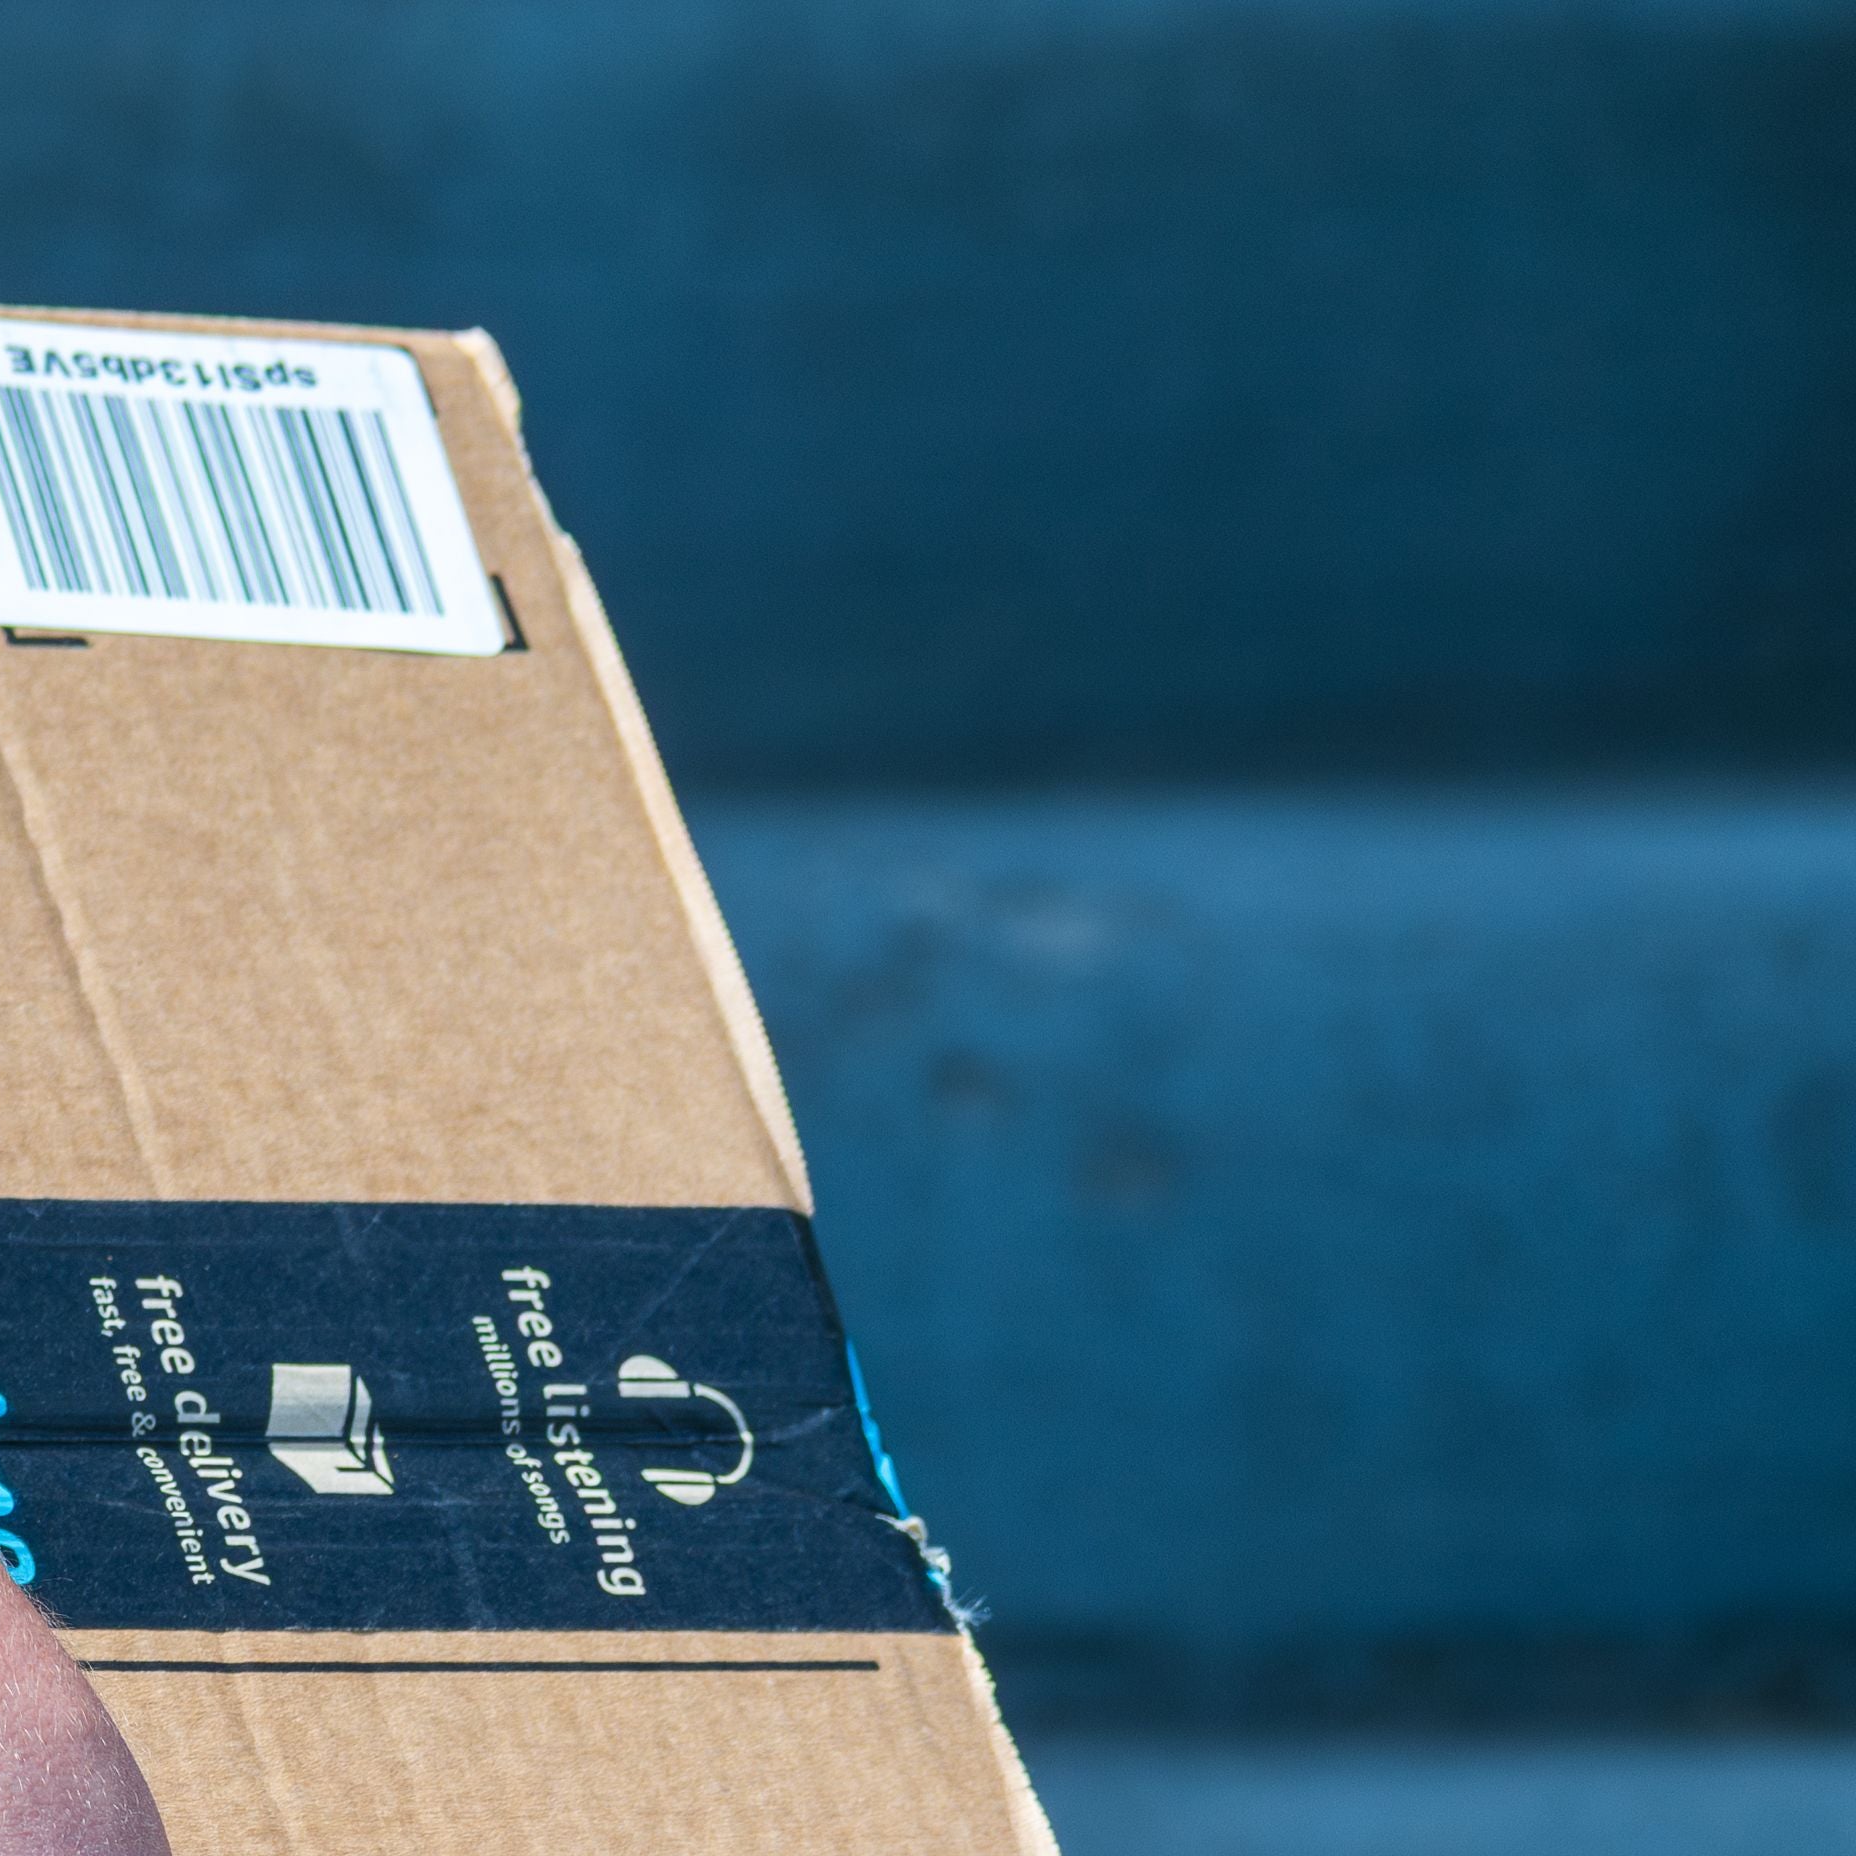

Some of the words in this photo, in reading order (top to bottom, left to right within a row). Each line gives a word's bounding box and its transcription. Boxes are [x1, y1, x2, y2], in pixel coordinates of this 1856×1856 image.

[89, 1276, 127, 1337] fast,
[113, 1346, 145, 1402] free
[472, 1315, 520, 1435] millions
[131, 1411, 156, 1437] &
[135, 1274, 194, 1375] free
[174, 1390, 270, 1586] delivery
[501, 1266, 563, 1368] free
[543, 1384, 646, 1596] listening
[505, 1442, 543, 1473] of
[136, 1446, 215, 1586] convenient
[522, 1470, 570, 1544] songs
